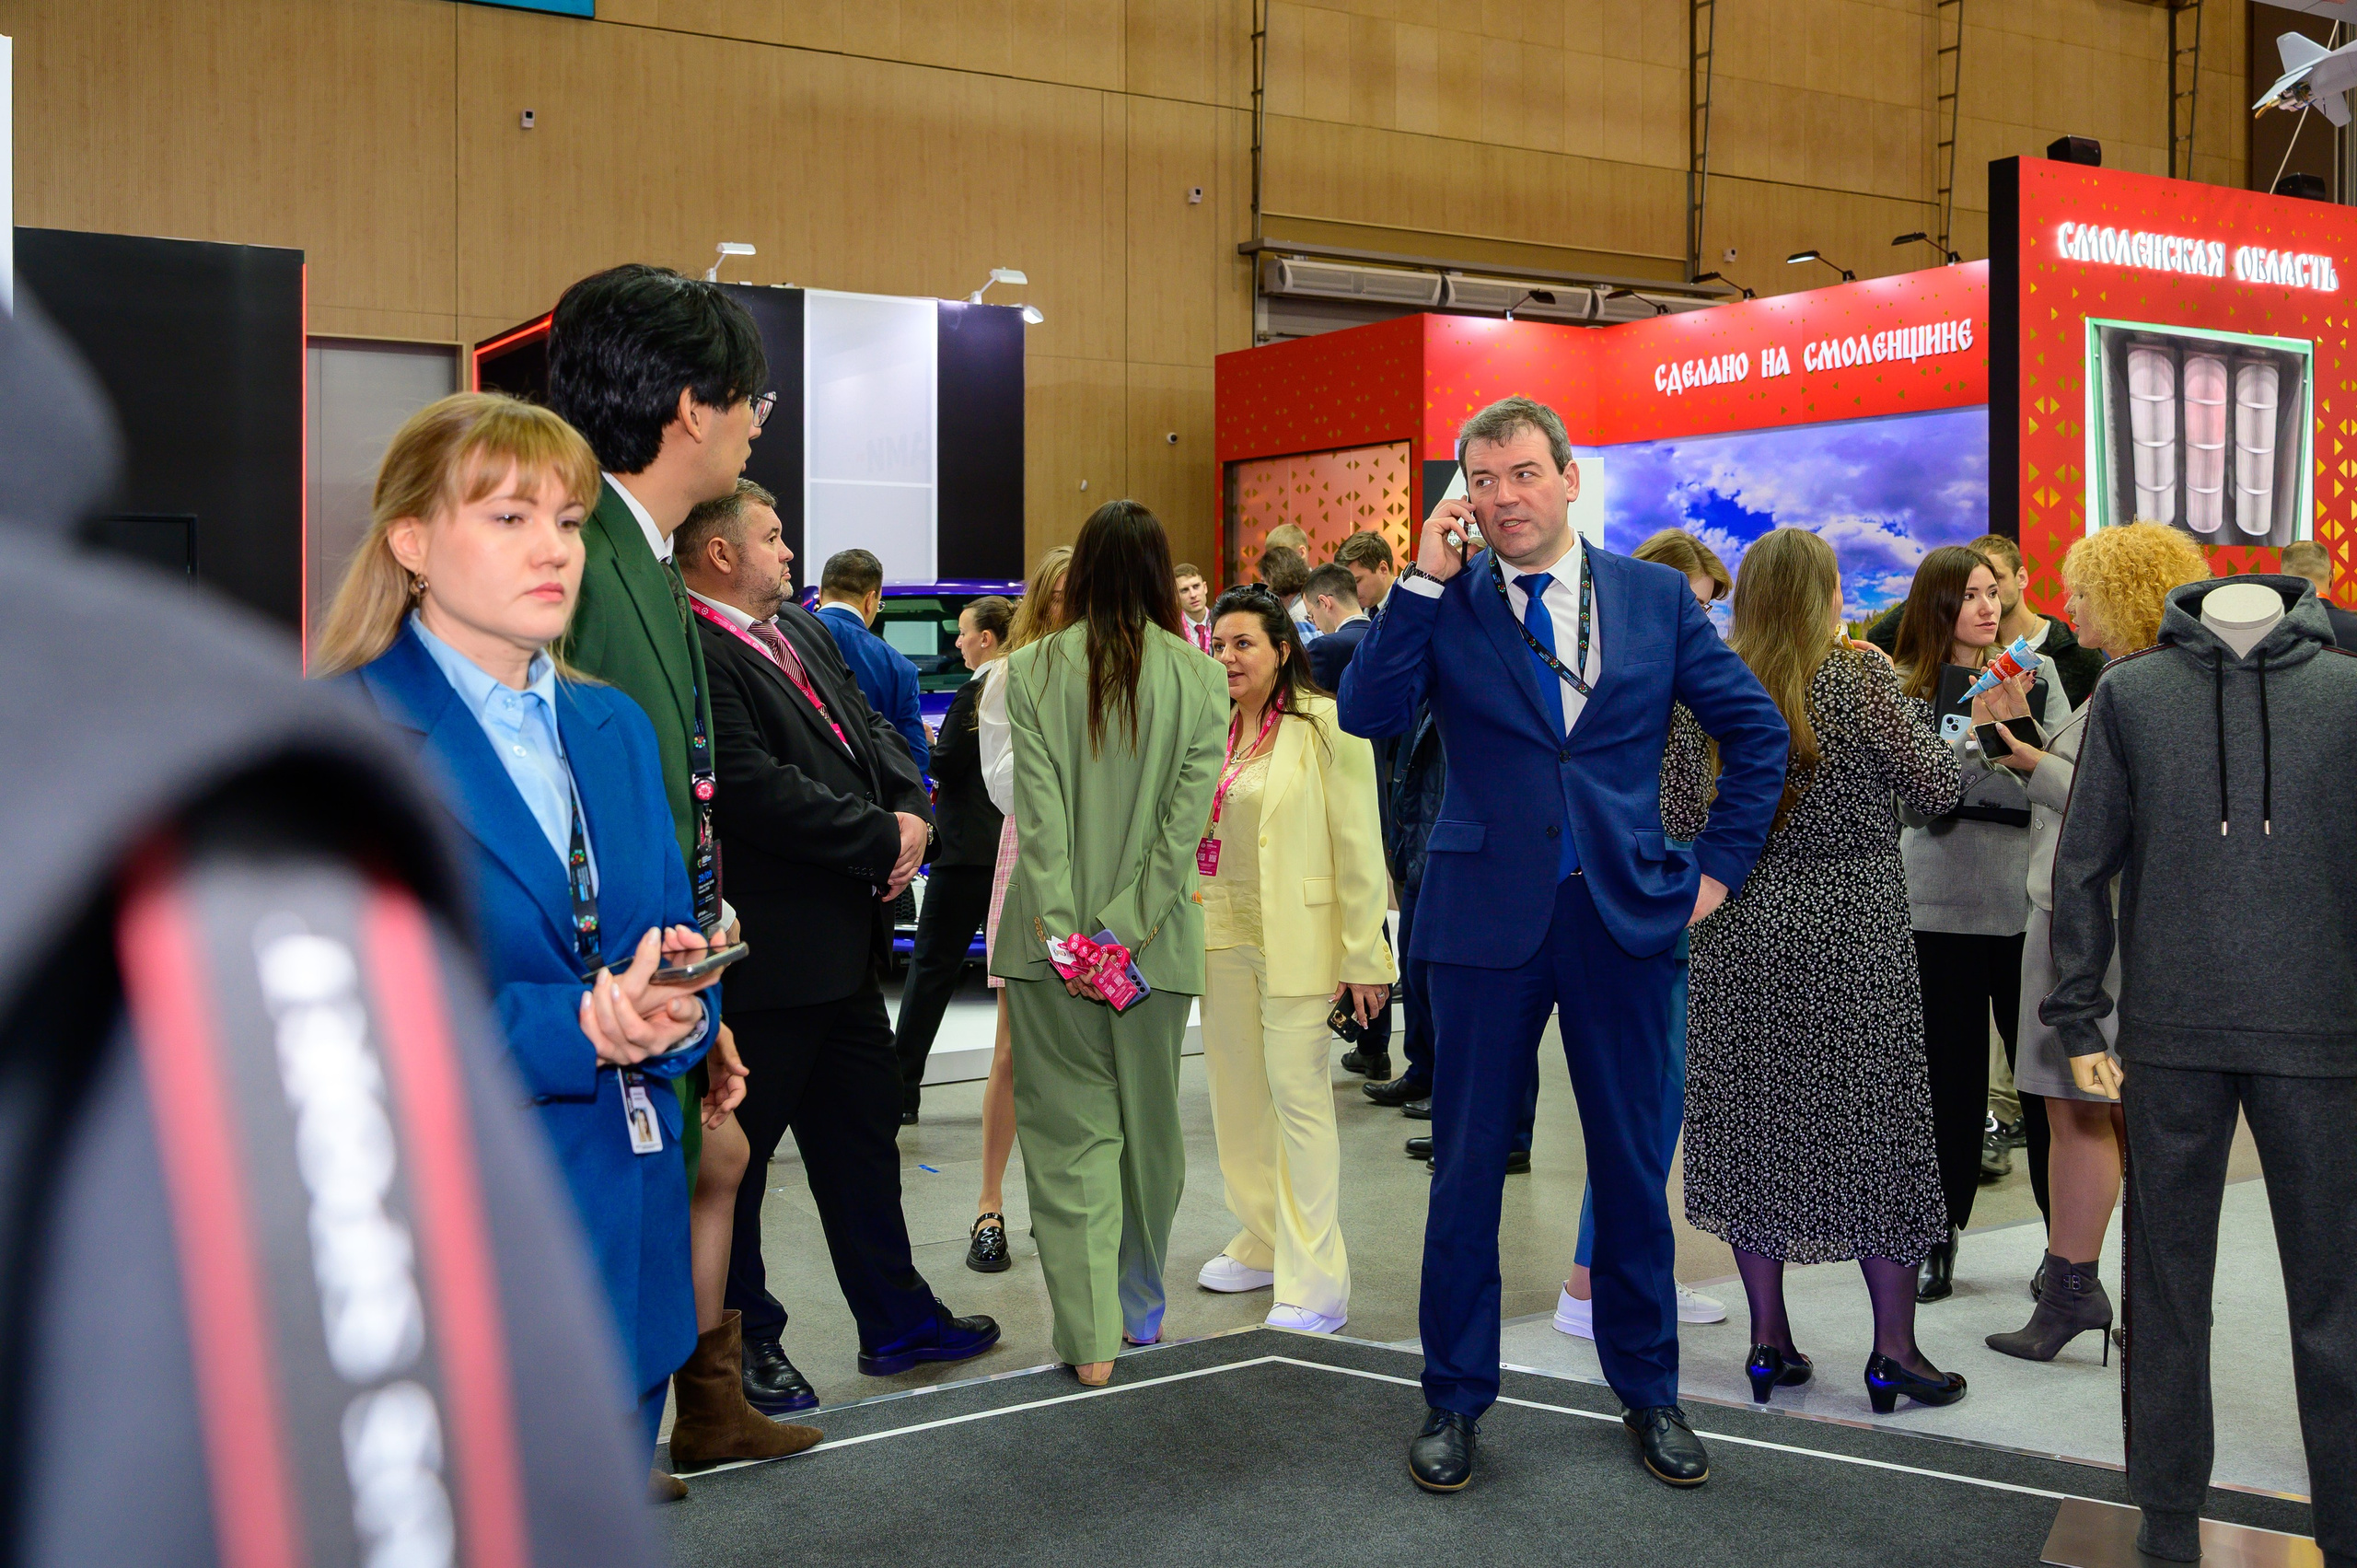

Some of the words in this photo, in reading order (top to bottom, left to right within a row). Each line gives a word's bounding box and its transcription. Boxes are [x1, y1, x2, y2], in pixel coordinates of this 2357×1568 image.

[2057, 221, 2226, 278] СМОЛЕНСКАЯ
[2235, 245, 2340, 292] ОБЛАСТЬ
[1654, 352, 1749, 397] СДЕЛАНО
[1760, 345, 1791, 378] НА
[1803, 318, 1974, 373] СМОЛЕНЩИНЕ
